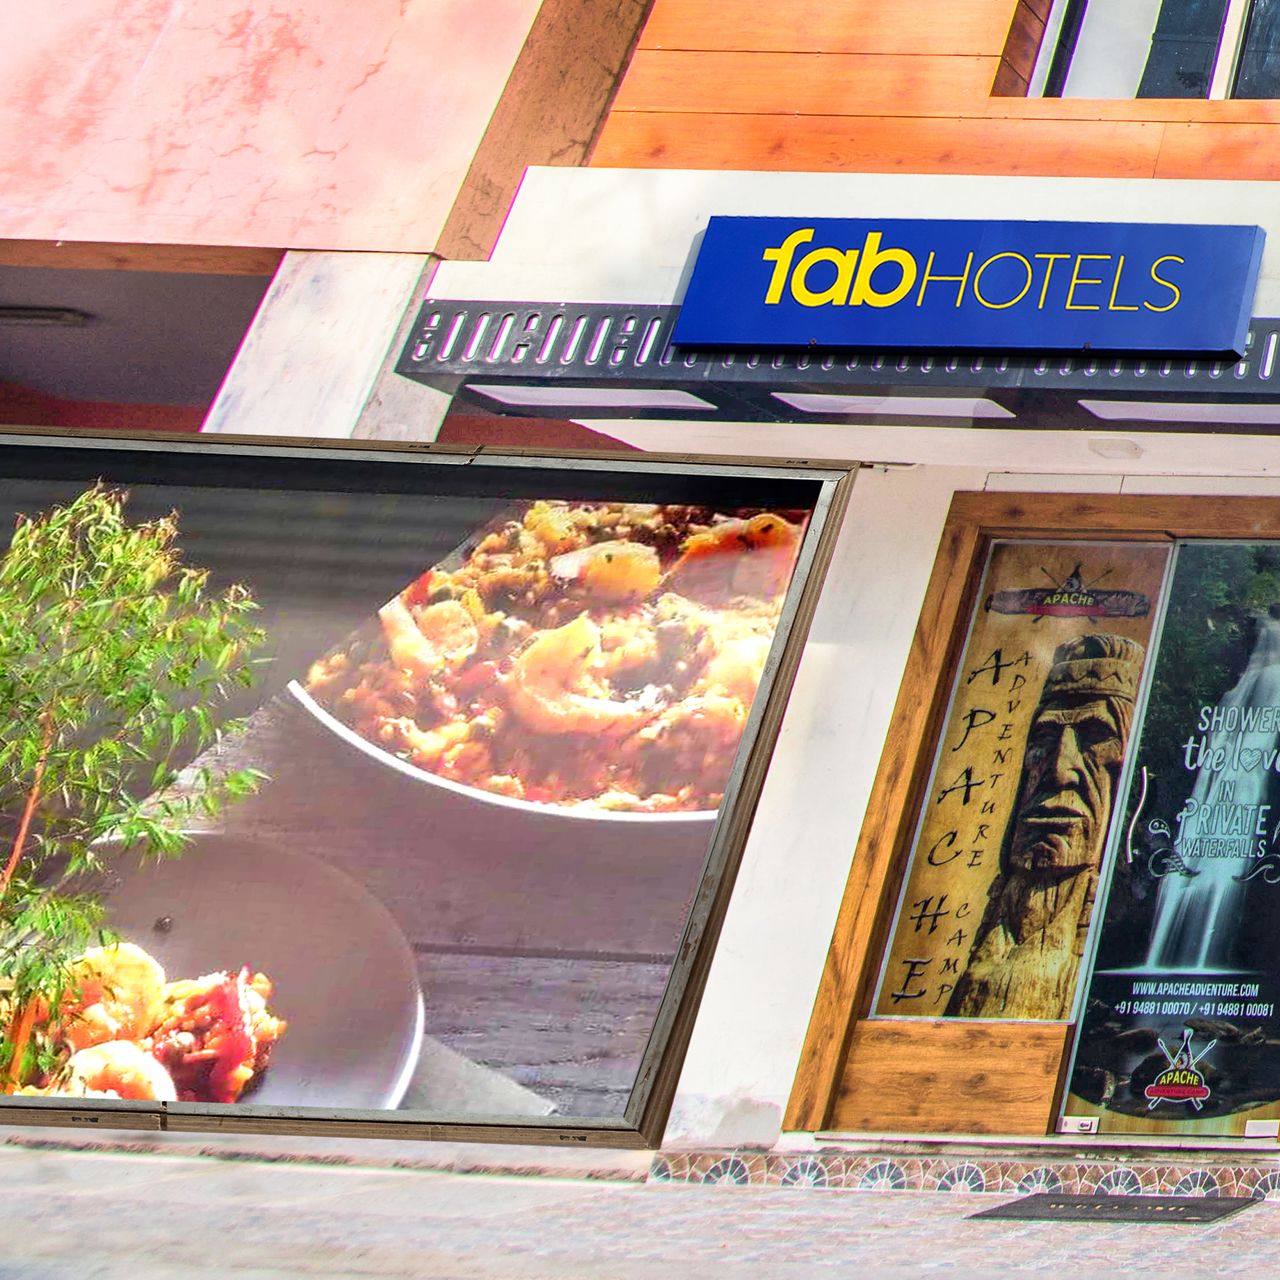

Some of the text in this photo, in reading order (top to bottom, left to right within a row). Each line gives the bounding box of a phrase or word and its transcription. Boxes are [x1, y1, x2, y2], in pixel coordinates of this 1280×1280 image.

[1043, 592, 1095, 606] APACHE
[1182, 735, 1226, 771] the
[1219, 780, 1236, 802] IN
[1174, 798, 1272, 847] PRIVATE
[1182, 837, 1267, 859] WATERFALLS
[1132, 982, 1260, 997] WWW.APACHEADVENTURE.COM
[1159, 1071, 1200, 1086] APACHE
